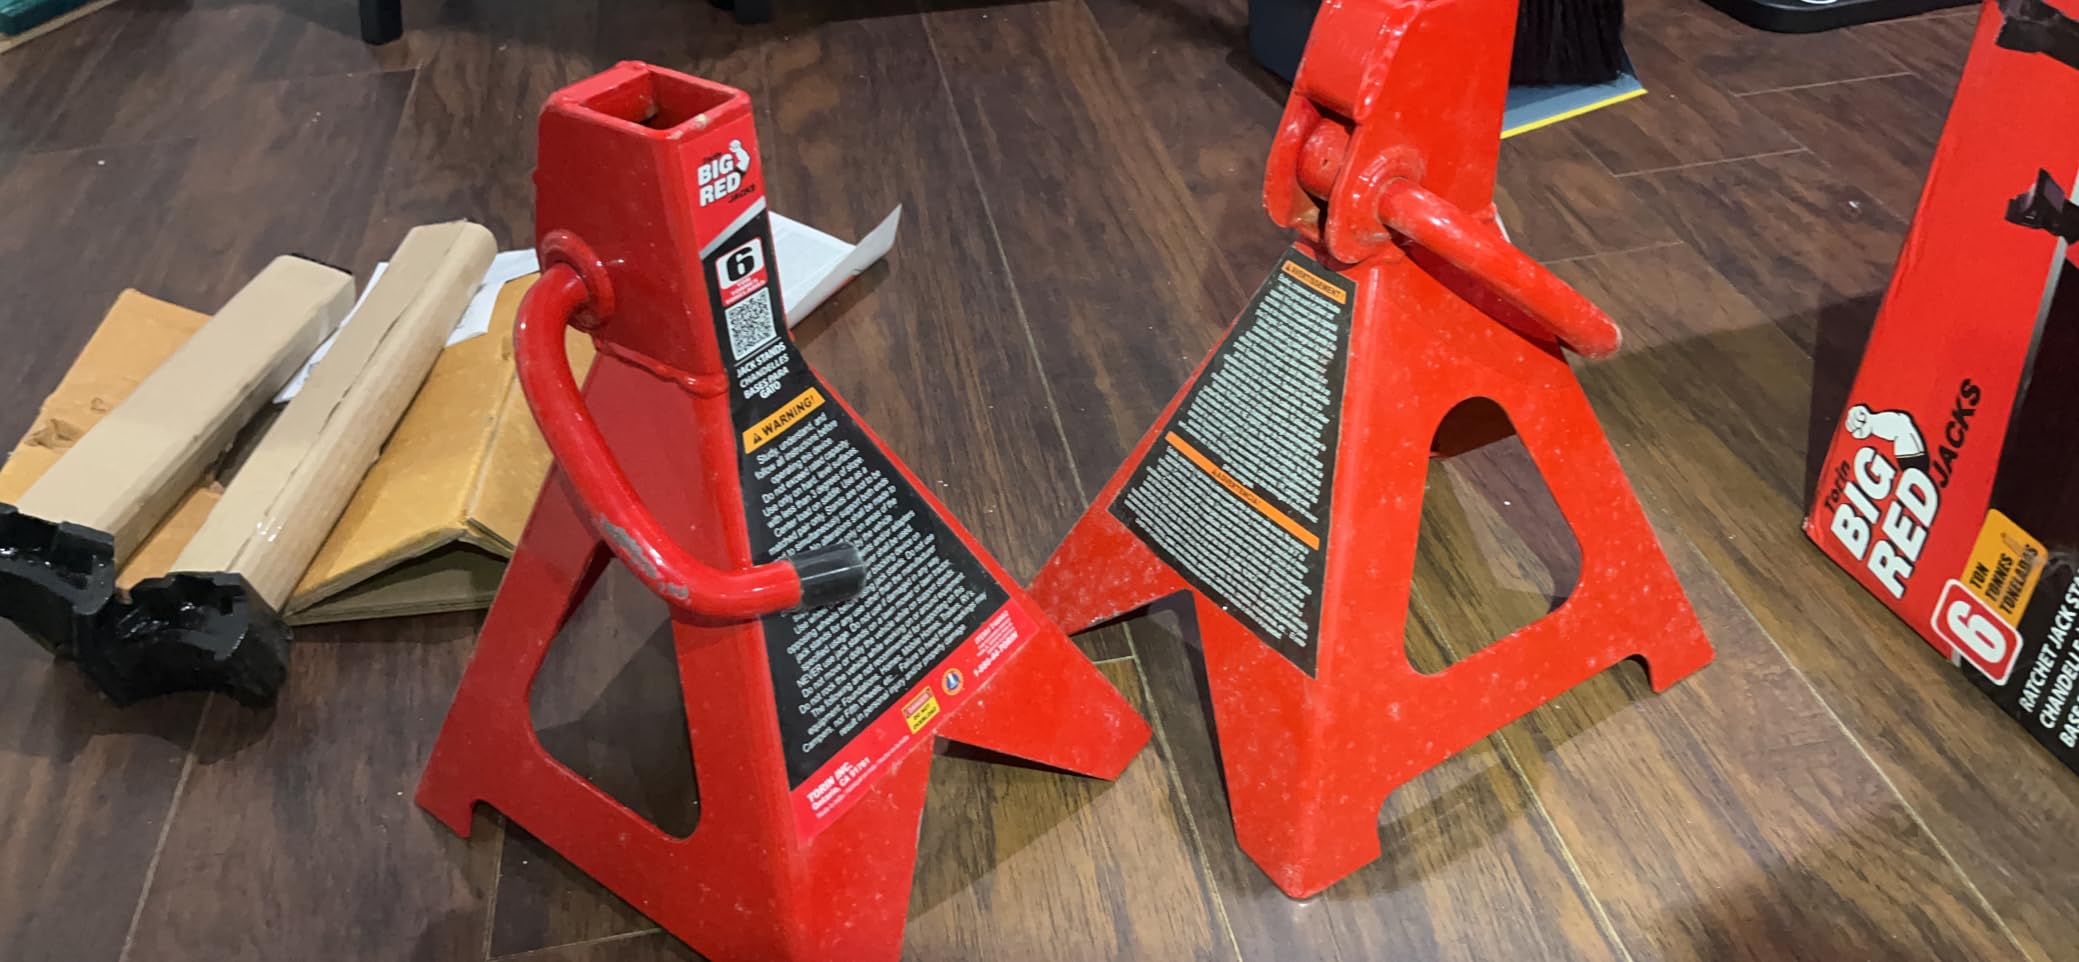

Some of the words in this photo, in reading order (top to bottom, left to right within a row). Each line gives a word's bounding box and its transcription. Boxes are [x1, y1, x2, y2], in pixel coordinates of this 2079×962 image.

[698, 153, 734, 187] BIG
[700, 171, 741, 207] RED
[727, 246, 755, 282] 6
[737, 360, 757, 379] JACK
[756, 341, 787, 366] STANDS
[740, 353, 790, 388] CHANDELLES
[744, 378, 769, 399] BASES
[767, 366, 790, 384] PARA
[760, 381, 782, 399] GATO
[762, 395, 814, 436] WARNING!
[1932, 378, 1982, 488] JACKS
[761, 492, 774, 503] Do
[1824, 459, 1850, 514] Torin
[1831, 447, 1897, 560] BIG
[1866, 467, 1940, 600] RED
[1969, 562, 1989, 590] TON
[1985, 553, 2014, 602] TONNES
[1946, 600, 2008, 664] 6
[2019, 643, 2058, 714] RATCHET
[2047, 604, 2077, 650] JACK
[2065, 570, 2079, 610] STA
[798, 702, 811, 714] Do
[801, 686, 813, 697] Do
[806, 775, 836, 802] TORIN
[839, 774, 851, 787] CA
